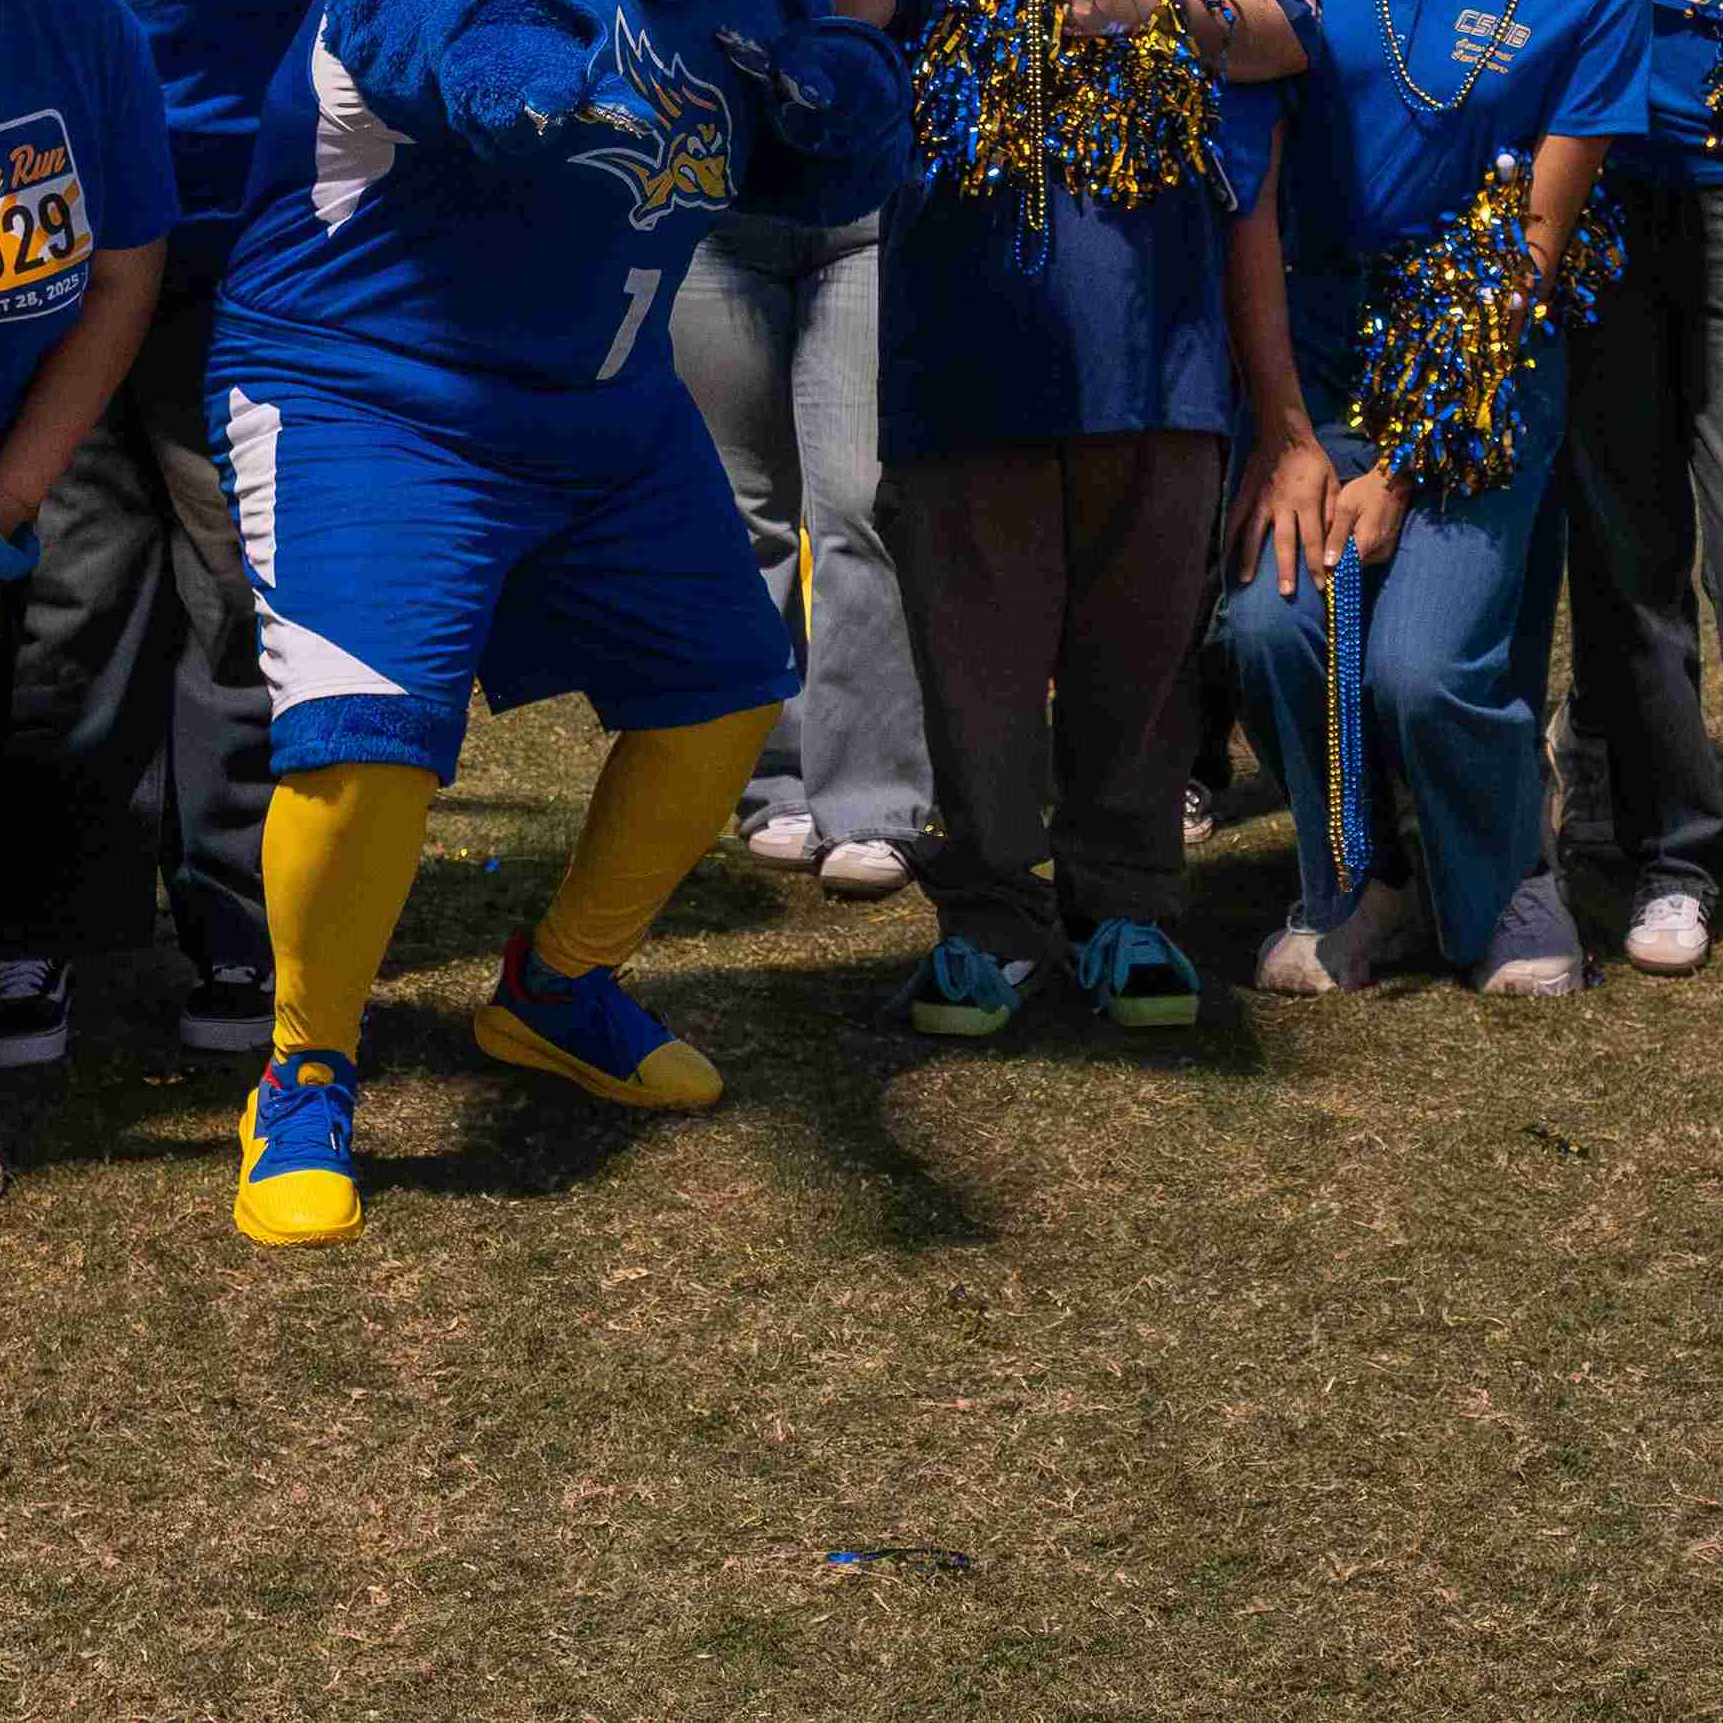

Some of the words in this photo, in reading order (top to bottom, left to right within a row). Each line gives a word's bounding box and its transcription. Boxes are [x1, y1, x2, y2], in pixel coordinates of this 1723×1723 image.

[9, 143, 67, 187] Run
[46, 273, 80, 301] 2025
[596, 267, 662, 380] 1
